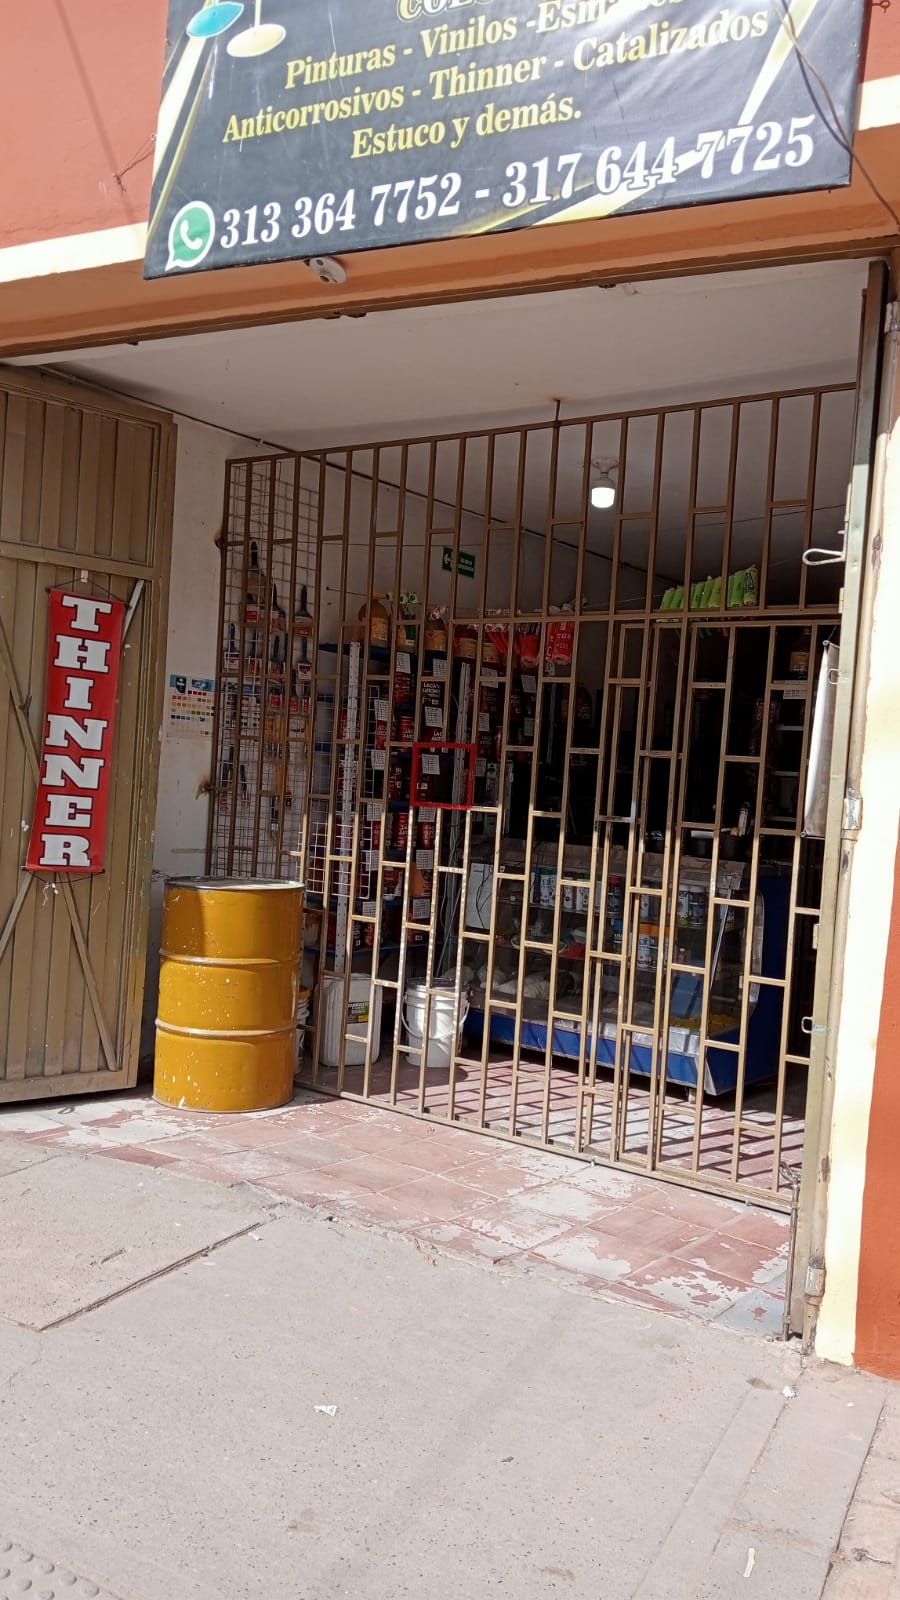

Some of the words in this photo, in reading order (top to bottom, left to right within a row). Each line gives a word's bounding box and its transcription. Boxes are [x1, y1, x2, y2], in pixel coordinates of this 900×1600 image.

[222, 84, 404, 143] Anticorrosivos
[412, 88, 421, 97] -
[429, 54, 547, 101] Thinner
[554, 59, 564, 69] -
[573, 8, 769, 71] Catalizados
[284, 45, 395, 90] Pinturas
[403, 47, 413, 57] -
[420, 14, 518, 59] Vinilos
[220, 200, 282, 249] 313
[291, 189, 357, 239] 364
[369, 171, 462, 227] 7752
[475, 188, 491, 200] -
[502, 153, 582, 208] 317
[596, 136, 681, 194] 644
[696, 114, 816, 180] 7725
[350, 116, 446, 160] Estuco
[450, 116, 470, 149] y
[476, 93, 582, 136] demás.
[39, 594, 113, 868] THINNER
